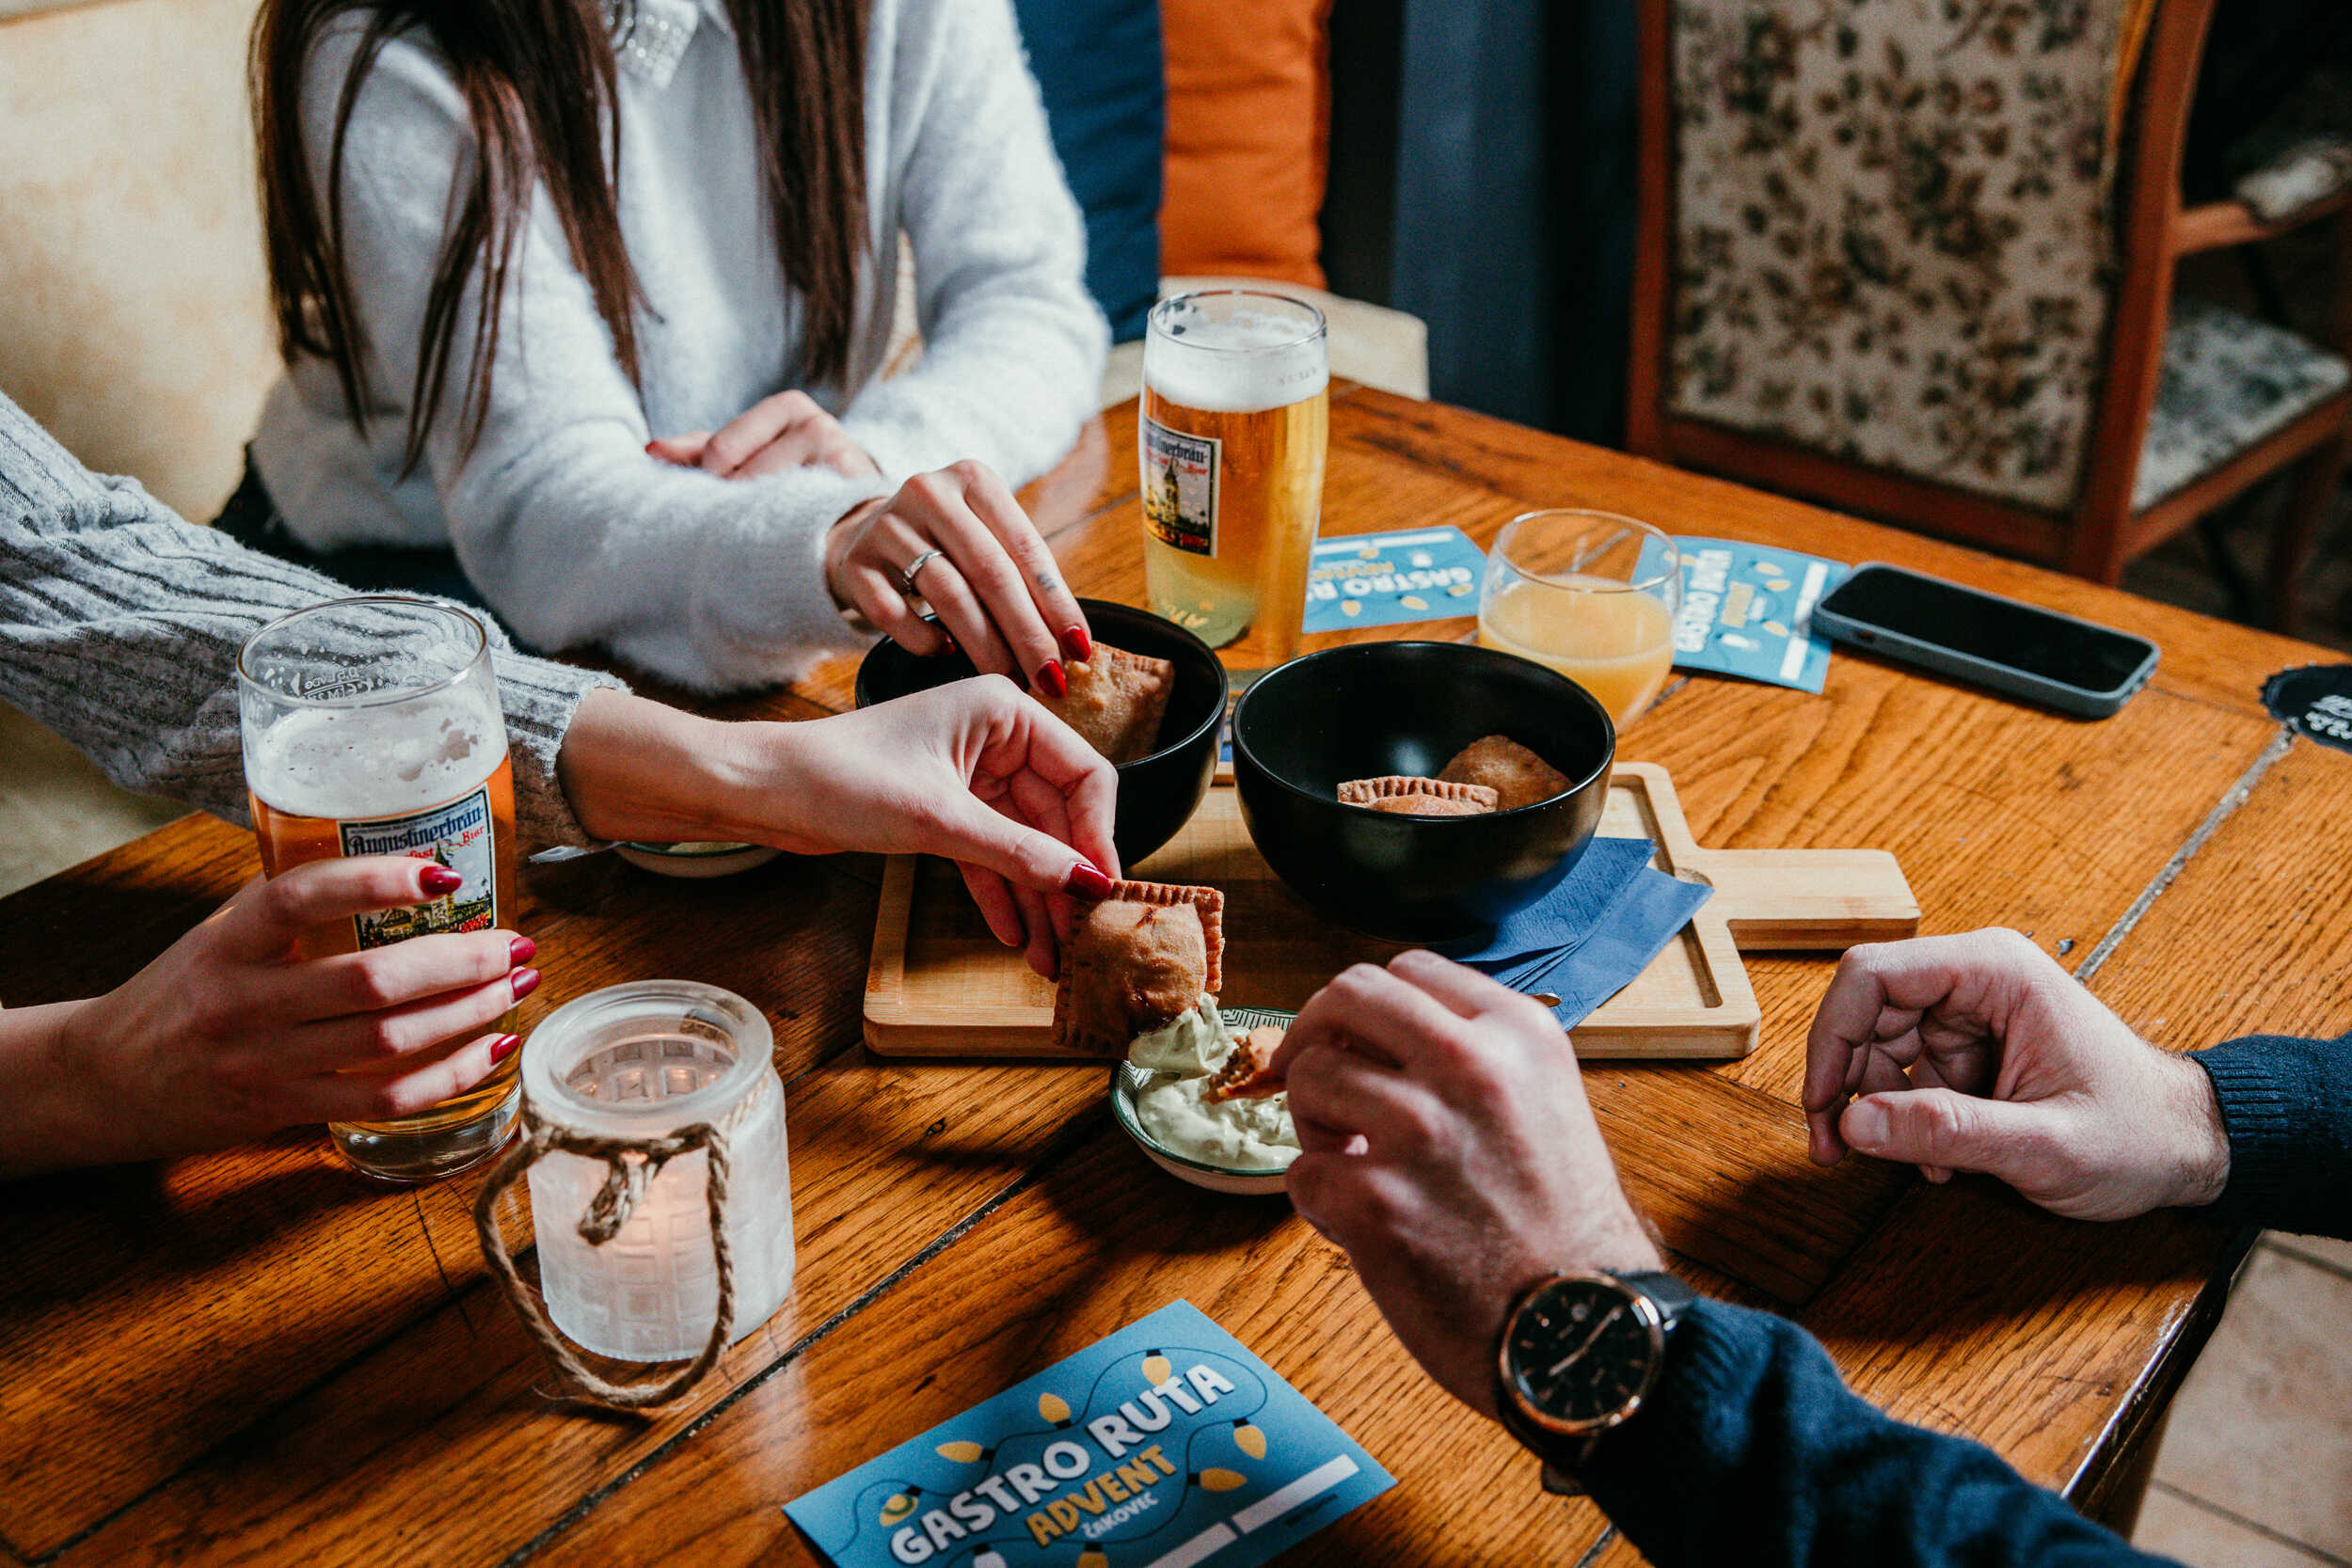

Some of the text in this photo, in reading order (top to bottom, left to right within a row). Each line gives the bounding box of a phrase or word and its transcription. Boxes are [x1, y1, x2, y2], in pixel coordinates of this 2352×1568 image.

[890, 1364, 1235, 1565] GASTRO RUTA
[1025, 1444, 1177, 1547] ADVENT
[1083, 1491, 1160, 1539] ČAKOVEC
